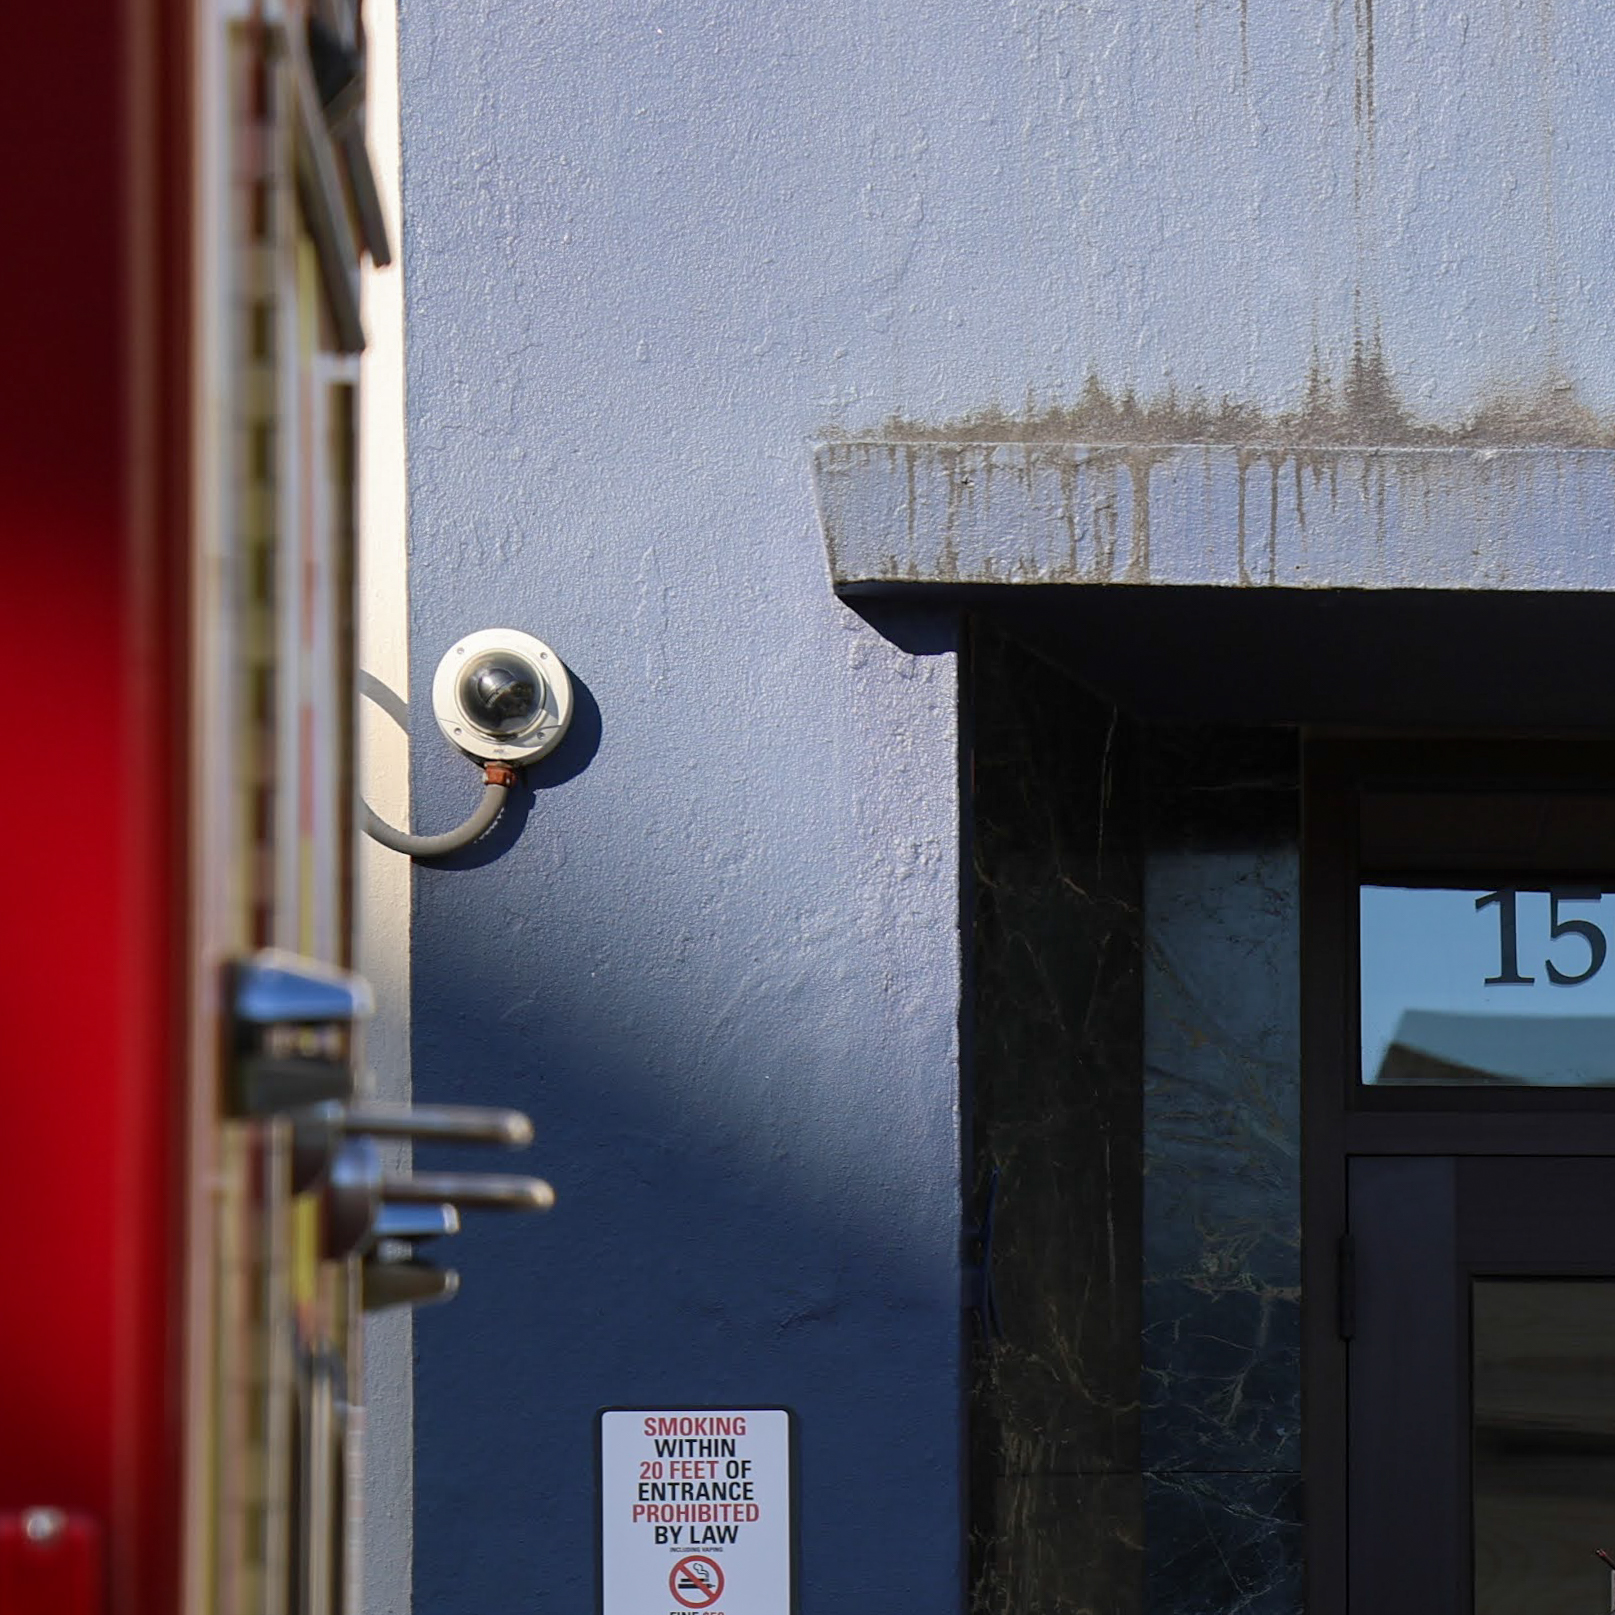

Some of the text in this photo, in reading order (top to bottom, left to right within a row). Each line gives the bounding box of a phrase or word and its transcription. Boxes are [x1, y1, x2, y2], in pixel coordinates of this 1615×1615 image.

[644, 1416, 746, 1437] SMOKING
[655, 1438, 736, 1458] WITHIN
[639, 1460, 751, 1480] 20 FEET OF
[638, 1481, 754, 1501] ENTRANCE
[632, 1503, 760, 1523] PROHIBITED
[655, 1525, 739, 1544] BY LAW
